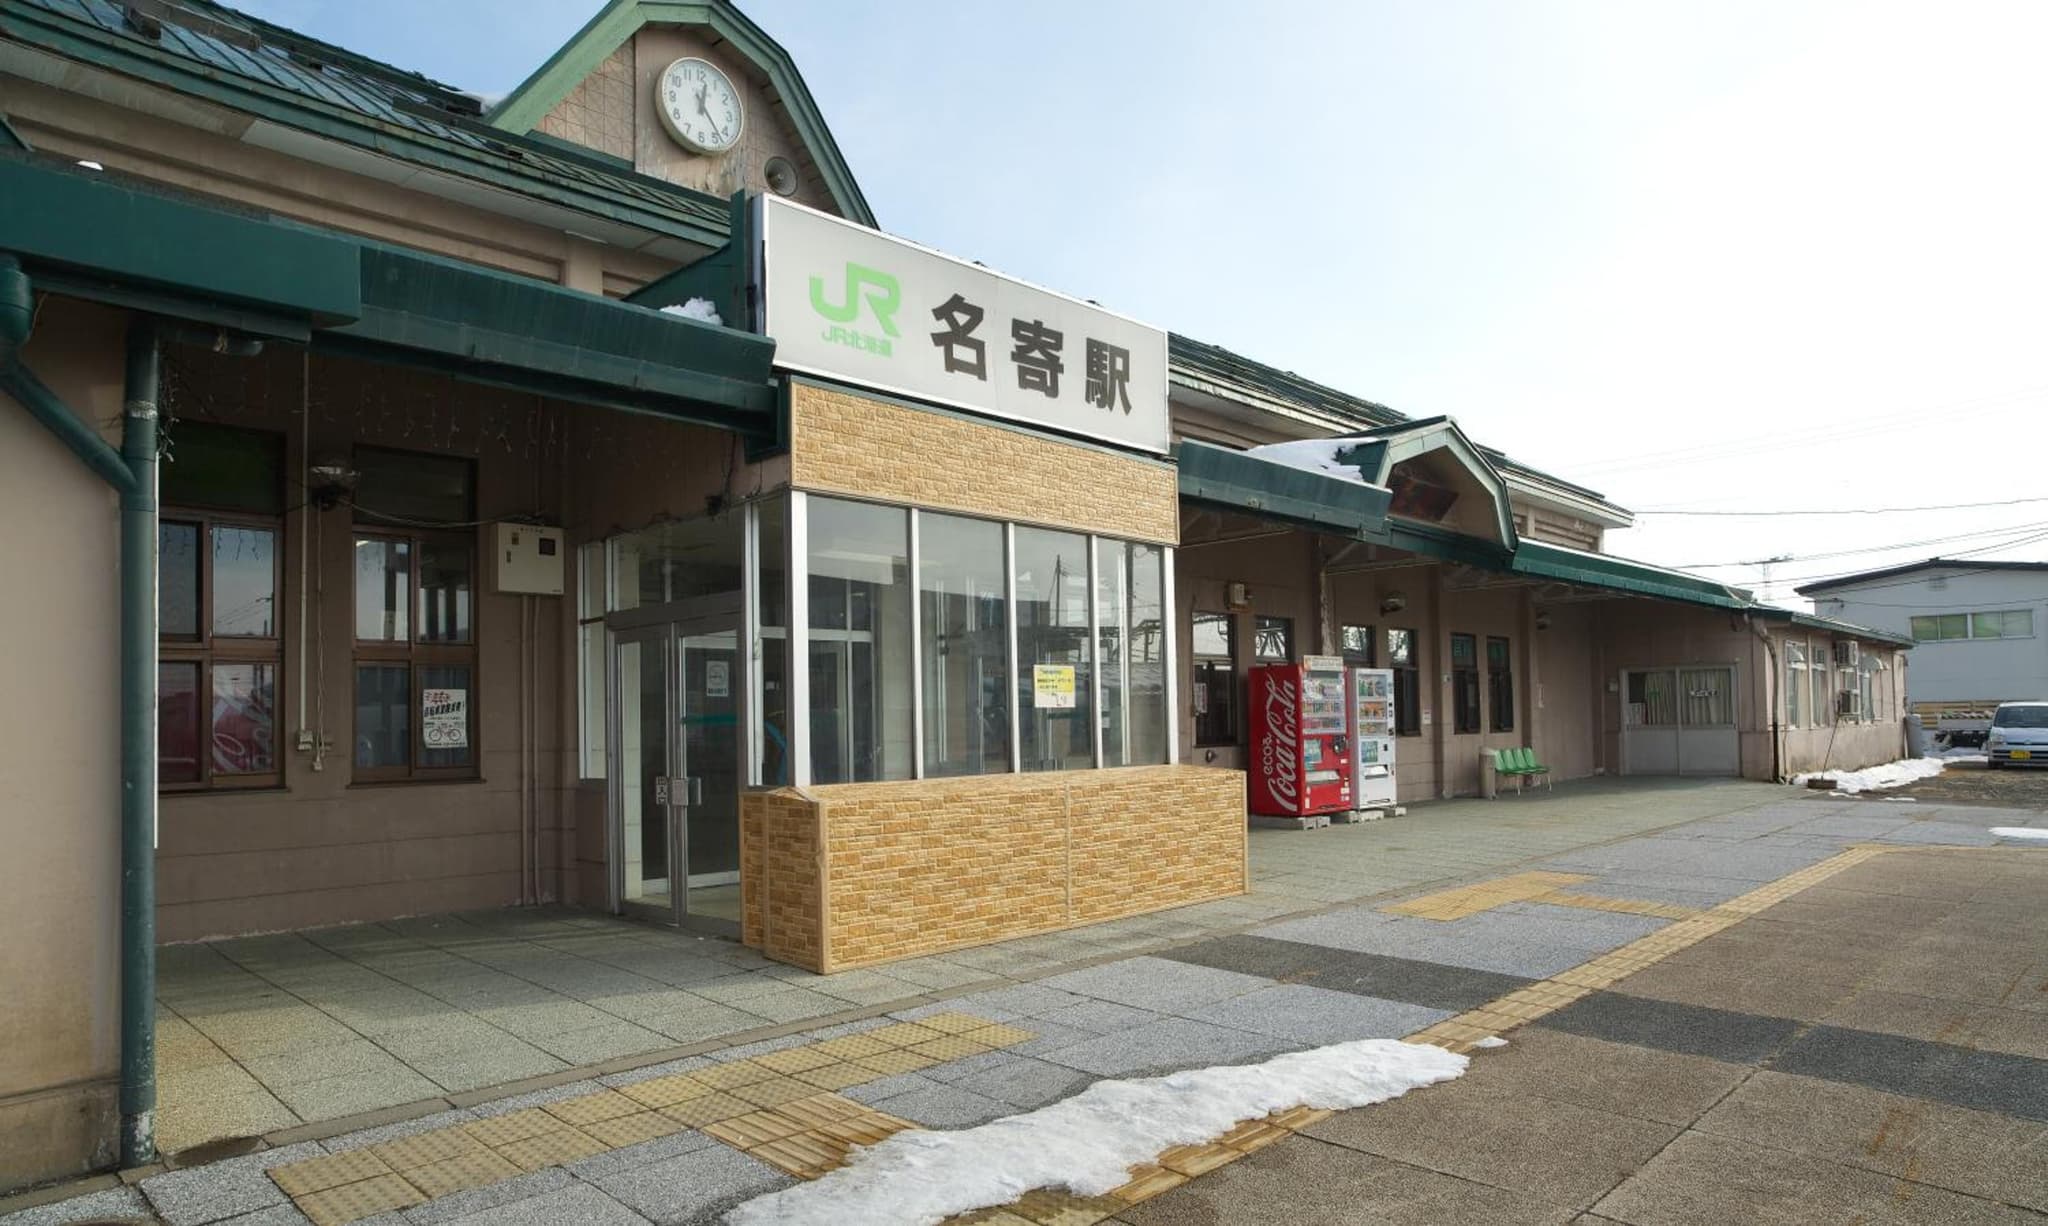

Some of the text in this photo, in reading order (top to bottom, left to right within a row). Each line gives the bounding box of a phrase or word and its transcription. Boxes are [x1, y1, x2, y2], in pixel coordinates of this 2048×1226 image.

[684, 69, 691, 81] 11
[696, 68, 706, 81] 12
[672, 75, 681, 88] 10
[722, 94, 729, 106] 2
[726, 111, 733, 122] 3
[684, 122, 691, 134] 7
[721, 126, 729, 137] 4
[711, 132, 720, 144] 5
[809, 261, 901, 338] JR
[930, 293, 1132, 416] 名寄駅
[1266, 672, 1298, 811] Coca-Cola
